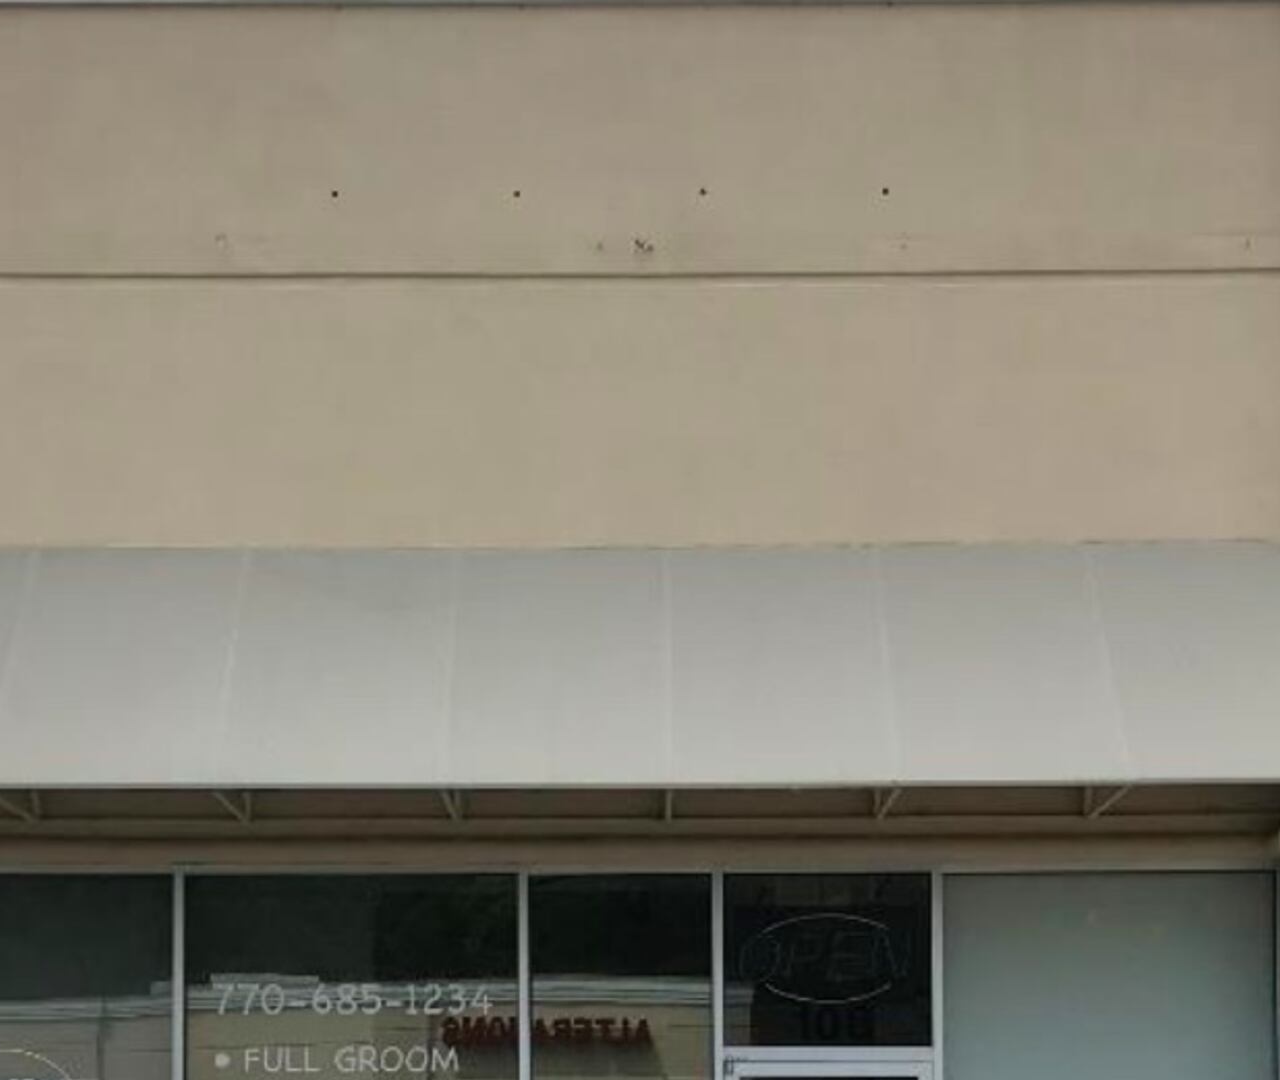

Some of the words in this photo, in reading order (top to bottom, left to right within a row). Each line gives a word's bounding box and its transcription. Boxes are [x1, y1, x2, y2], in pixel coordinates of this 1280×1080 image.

[211, 983, 493, 1016] 770-685-1234
[243, 1047, 320, 1073] FULL
[334, 1045, 460, 1073] GROOM
